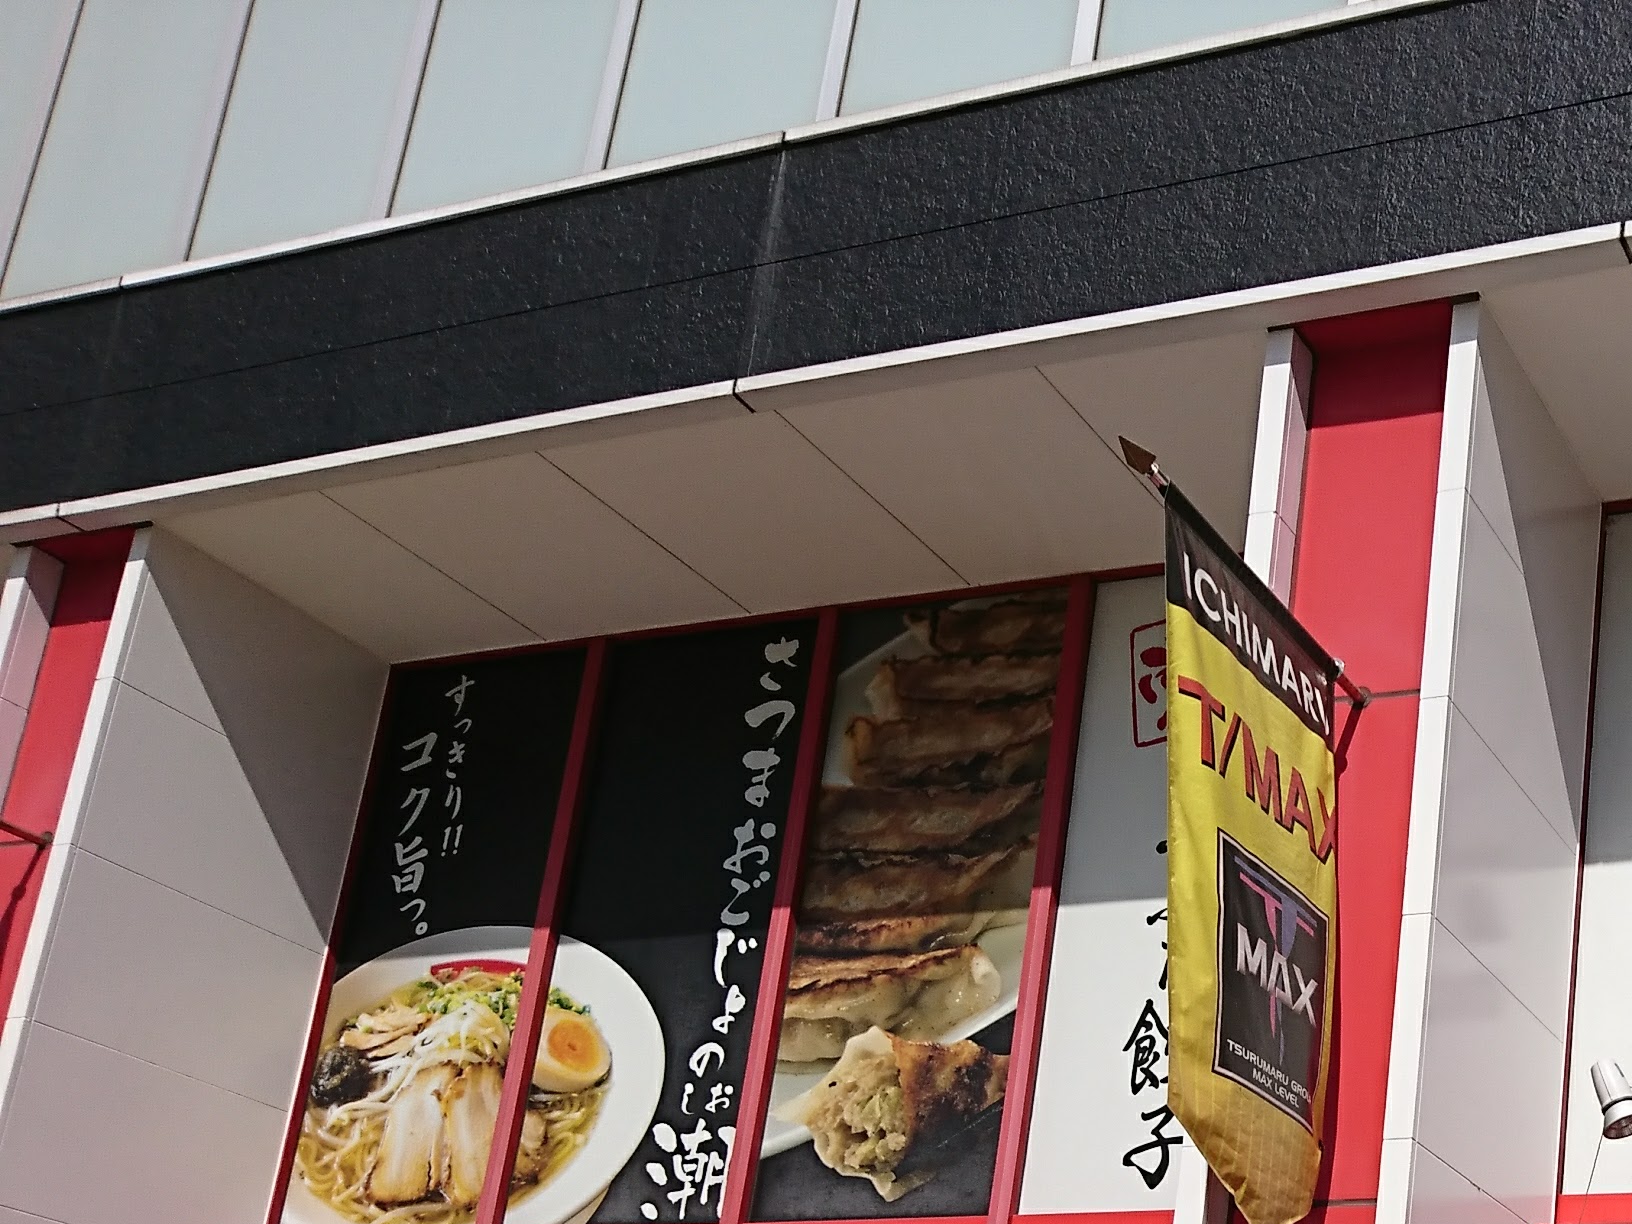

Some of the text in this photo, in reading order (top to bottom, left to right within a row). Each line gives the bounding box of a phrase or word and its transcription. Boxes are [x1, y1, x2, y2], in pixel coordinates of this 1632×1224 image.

[444, 674, 475, 857] すっきり!!
[1236, 922, 1319, 1028] MAX
[1226, 1038, 1289, 1087] TSURUMARU
[1252, 1067, 1300, 1109] MAX LEVEL
